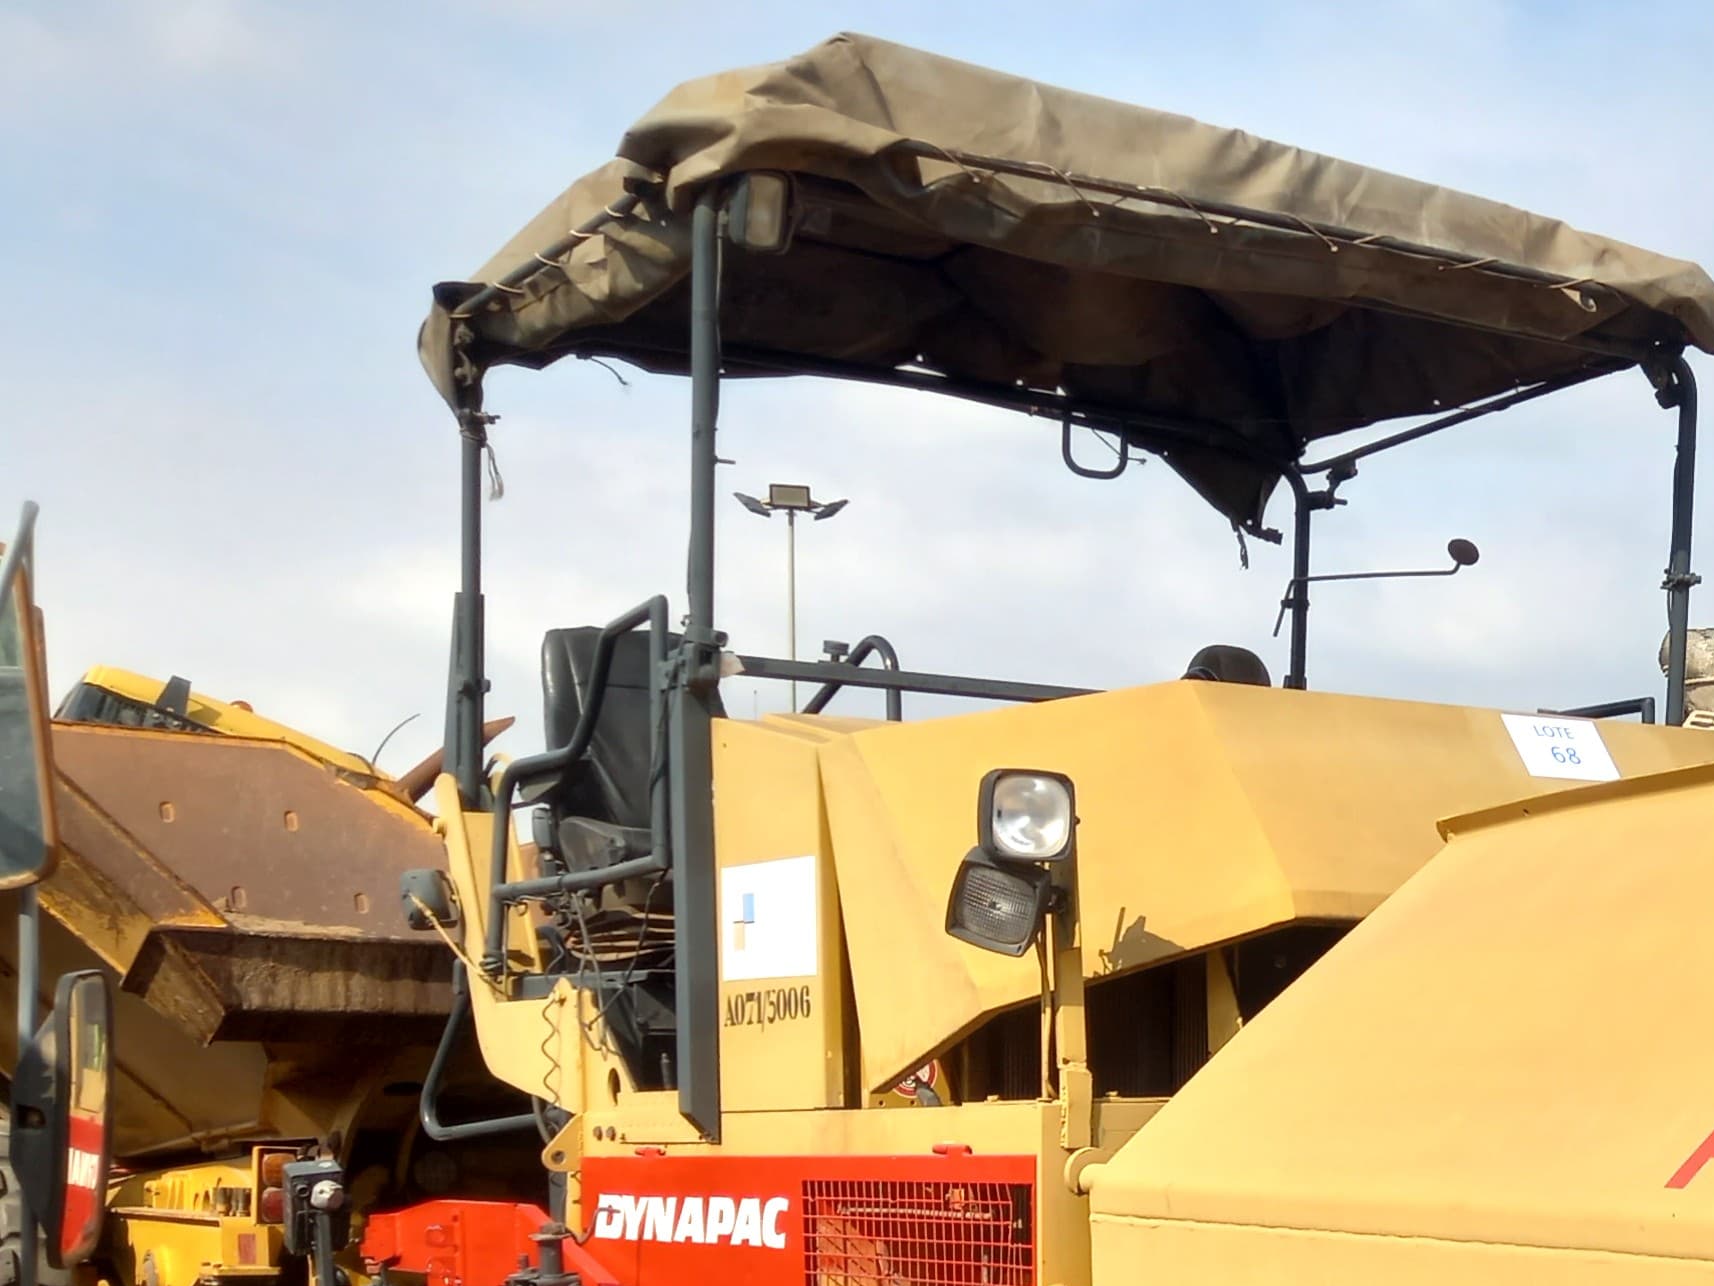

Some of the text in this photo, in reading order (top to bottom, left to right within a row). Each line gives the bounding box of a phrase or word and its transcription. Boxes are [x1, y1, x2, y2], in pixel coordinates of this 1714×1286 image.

[1533, 725, 1575, 740] LOTE
[1550, 746, 1582, 765] 68
[724, 985, 812, 1033] A071/5006
[594, 1193, 790, 1250] DYNAPAC
